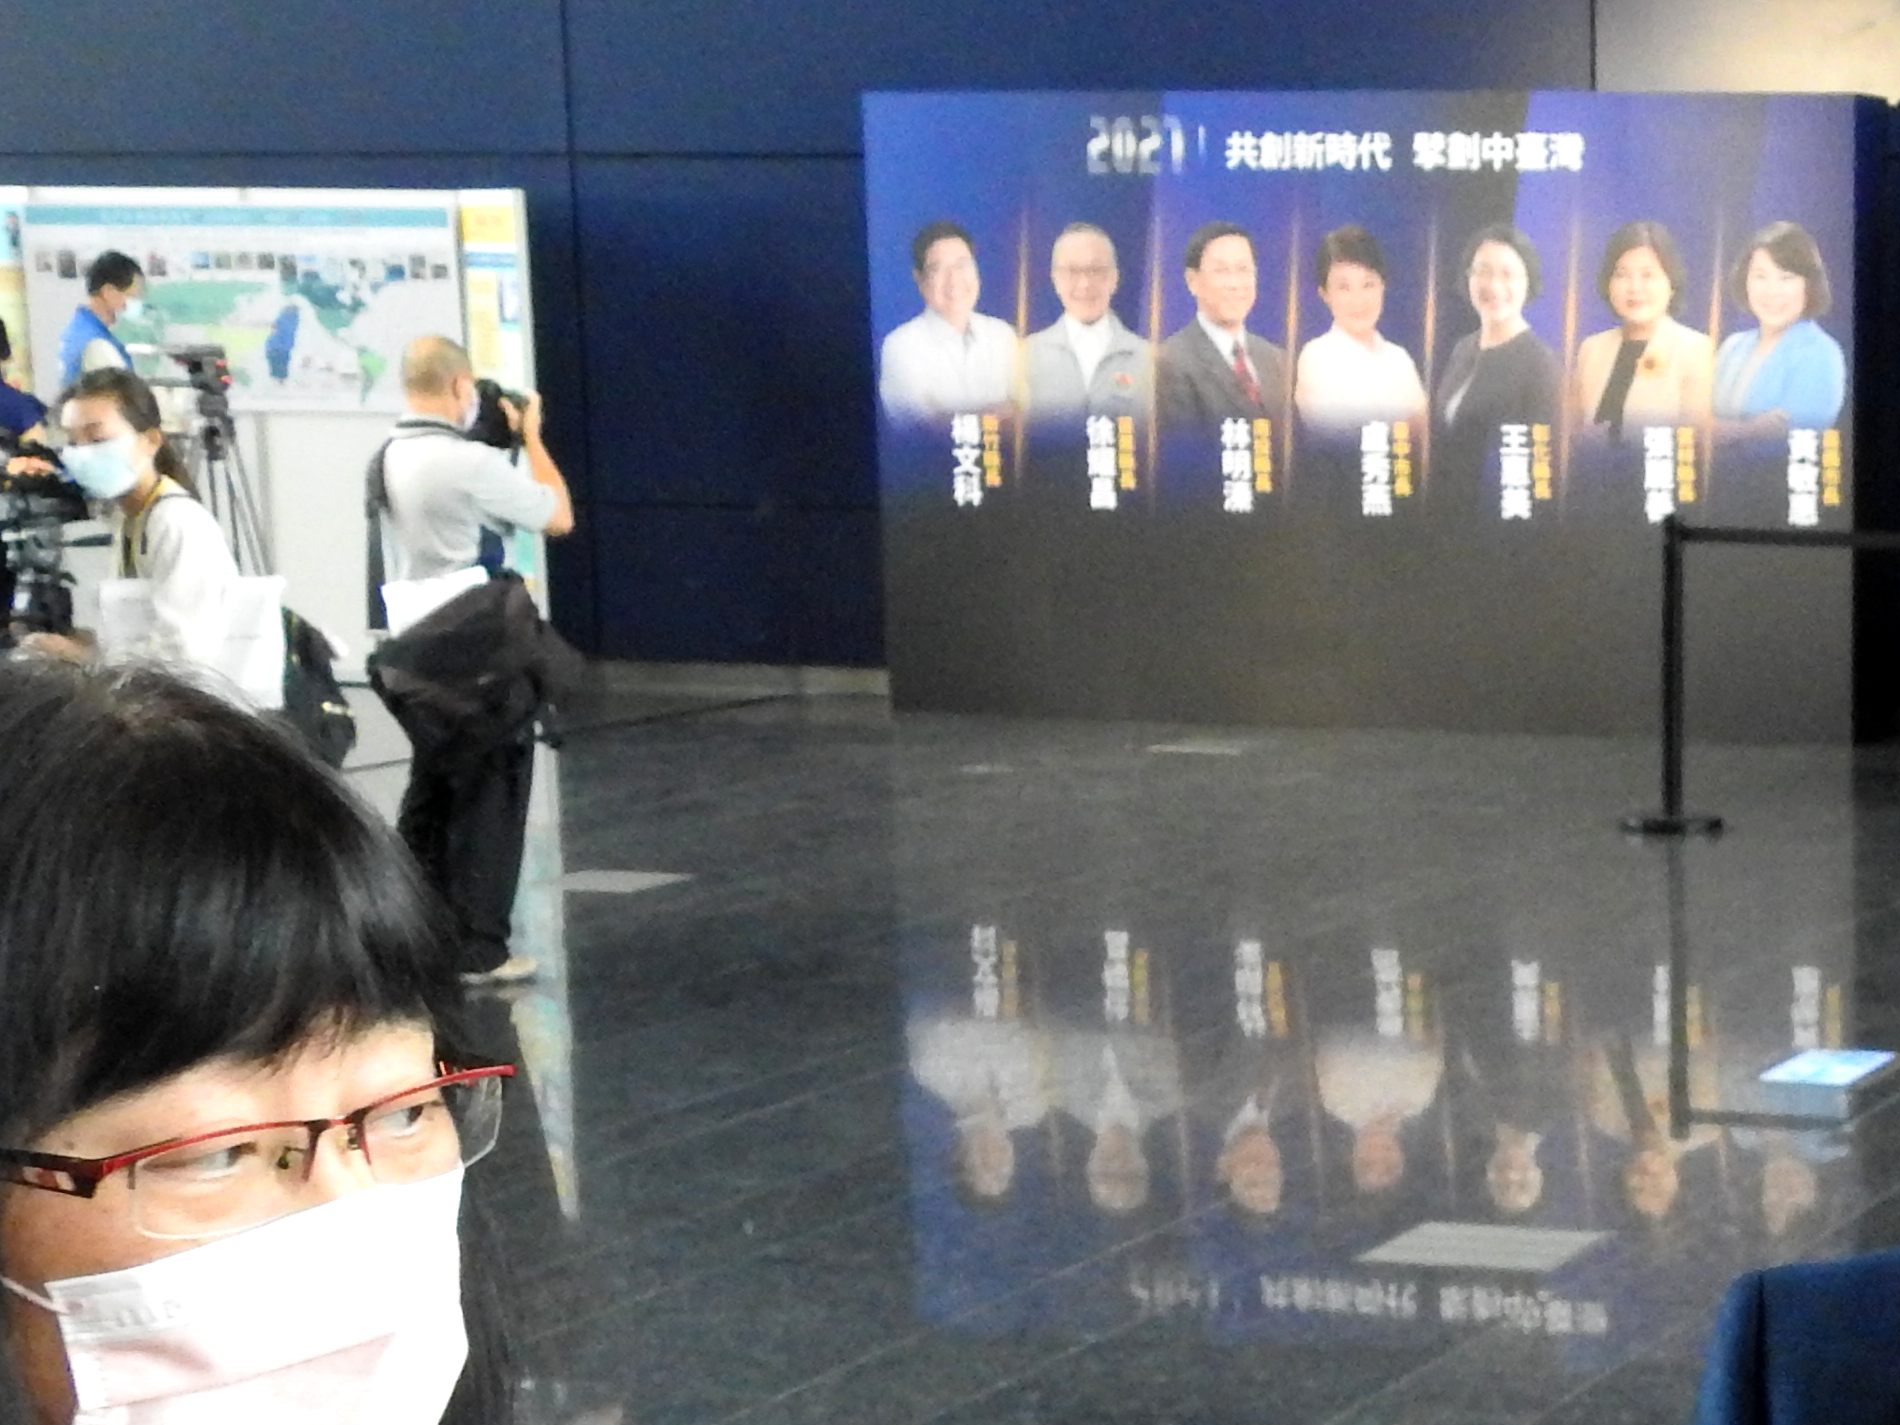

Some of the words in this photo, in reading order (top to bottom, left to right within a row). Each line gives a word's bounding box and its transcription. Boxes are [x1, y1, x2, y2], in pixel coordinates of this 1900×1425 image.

[1225, 131, 1393, 170] 共創新時代
